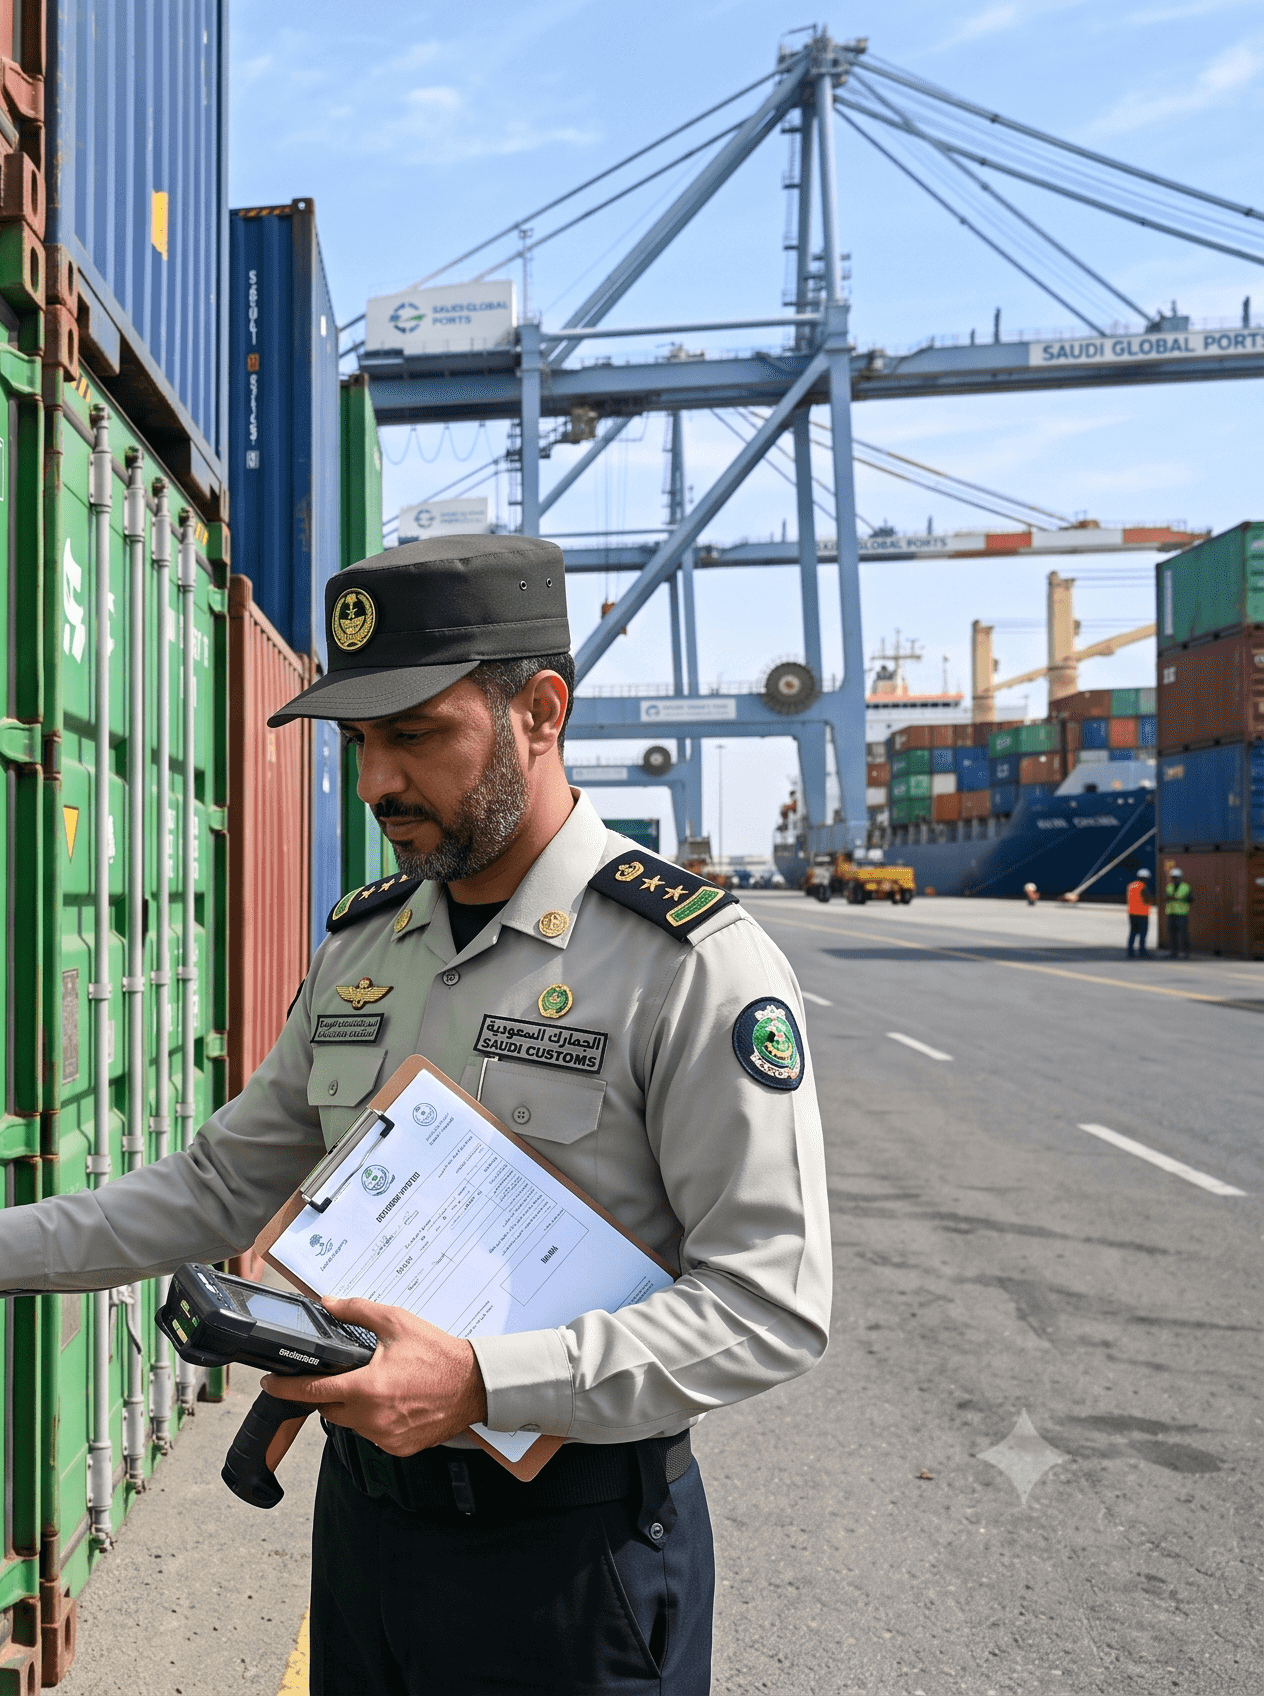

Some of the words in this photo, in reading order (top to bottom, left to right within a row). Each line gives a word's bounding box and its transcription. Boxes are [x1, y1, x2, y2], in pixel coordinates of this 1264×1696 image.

[1042, 341, 1105, 362] SAUDI
[1112, 336, 1195, 357] GLOBAL
[486, 1020, 546, 1042] السعودية
[547, 1030, 601, 1052] الجمارك
[481, 1037, 523, 1055] SAUDI
[525, 1045, 597, 1068] CUSTOMS
